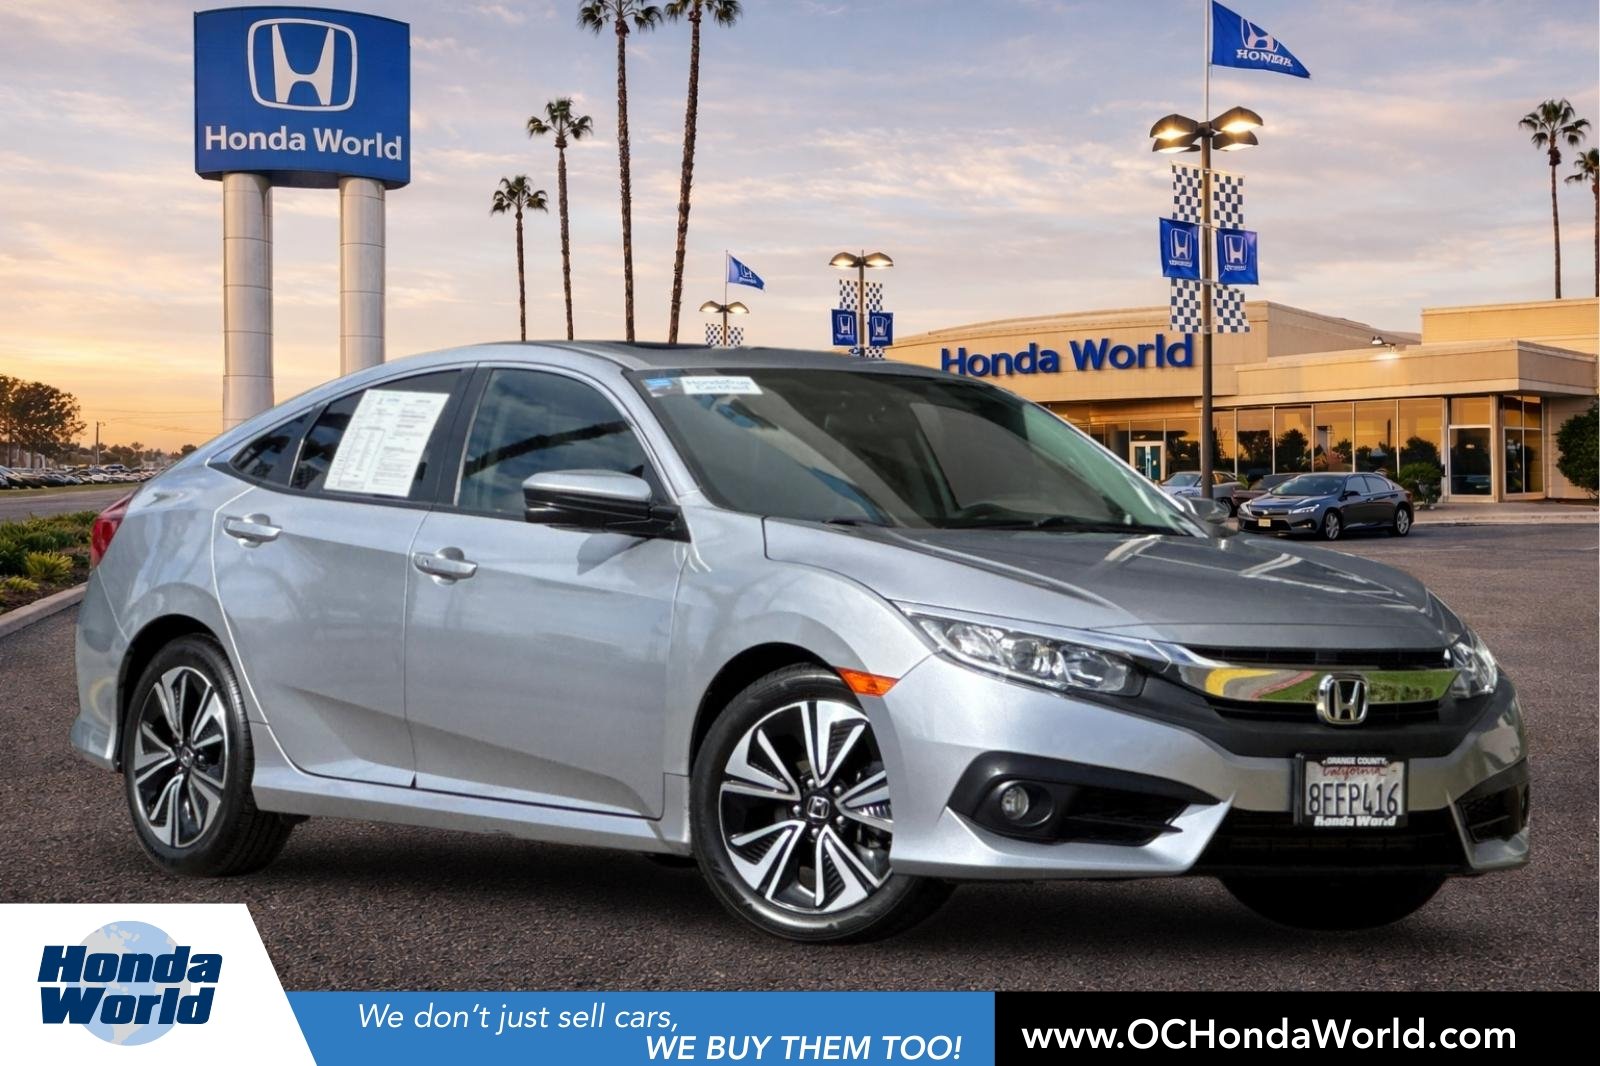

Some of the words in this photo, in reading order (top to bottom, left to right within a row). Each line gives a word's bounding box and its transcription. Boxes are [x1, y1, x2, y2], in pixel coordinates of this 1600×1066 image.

[205, 125, 305, 152] Honda
[312, 127, 402, 161] World
[941, 342, 1061, 378] Honda
[1069, 333, 1194, 371] World
[1327, 756, 1356, 765] ORANGE
[1357, 756, 1386, 765] COUNTY
[1322, 766, 1386, 780] California
[1308, 782, 1399, 816] 8FFP416
[1313, 815, 1355, 827] Honda
[1356, 815, 1397, 827] World
